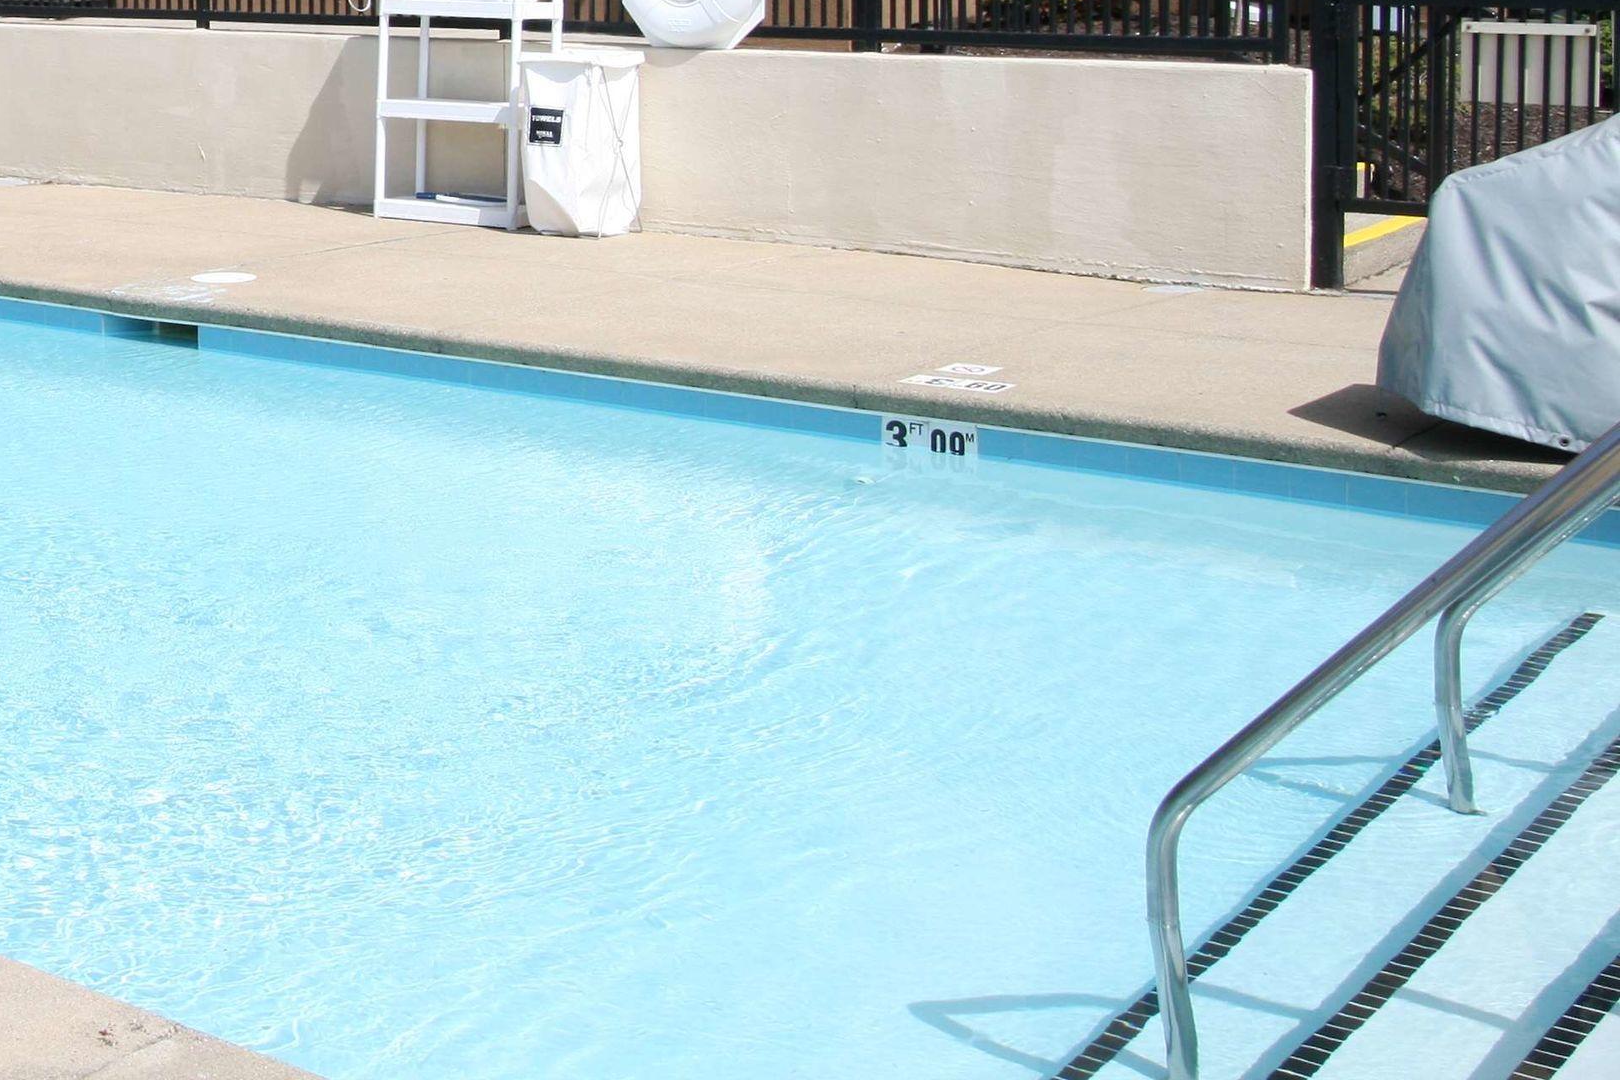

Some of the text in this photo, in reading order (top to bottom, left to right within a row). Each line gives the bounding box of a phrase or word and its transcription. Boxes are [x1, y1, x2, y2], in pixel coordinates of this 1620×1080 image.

[886, 419, 908, 448] 3
[909, 422, 924, 436] FT
[965, 432, 975, 444] M
